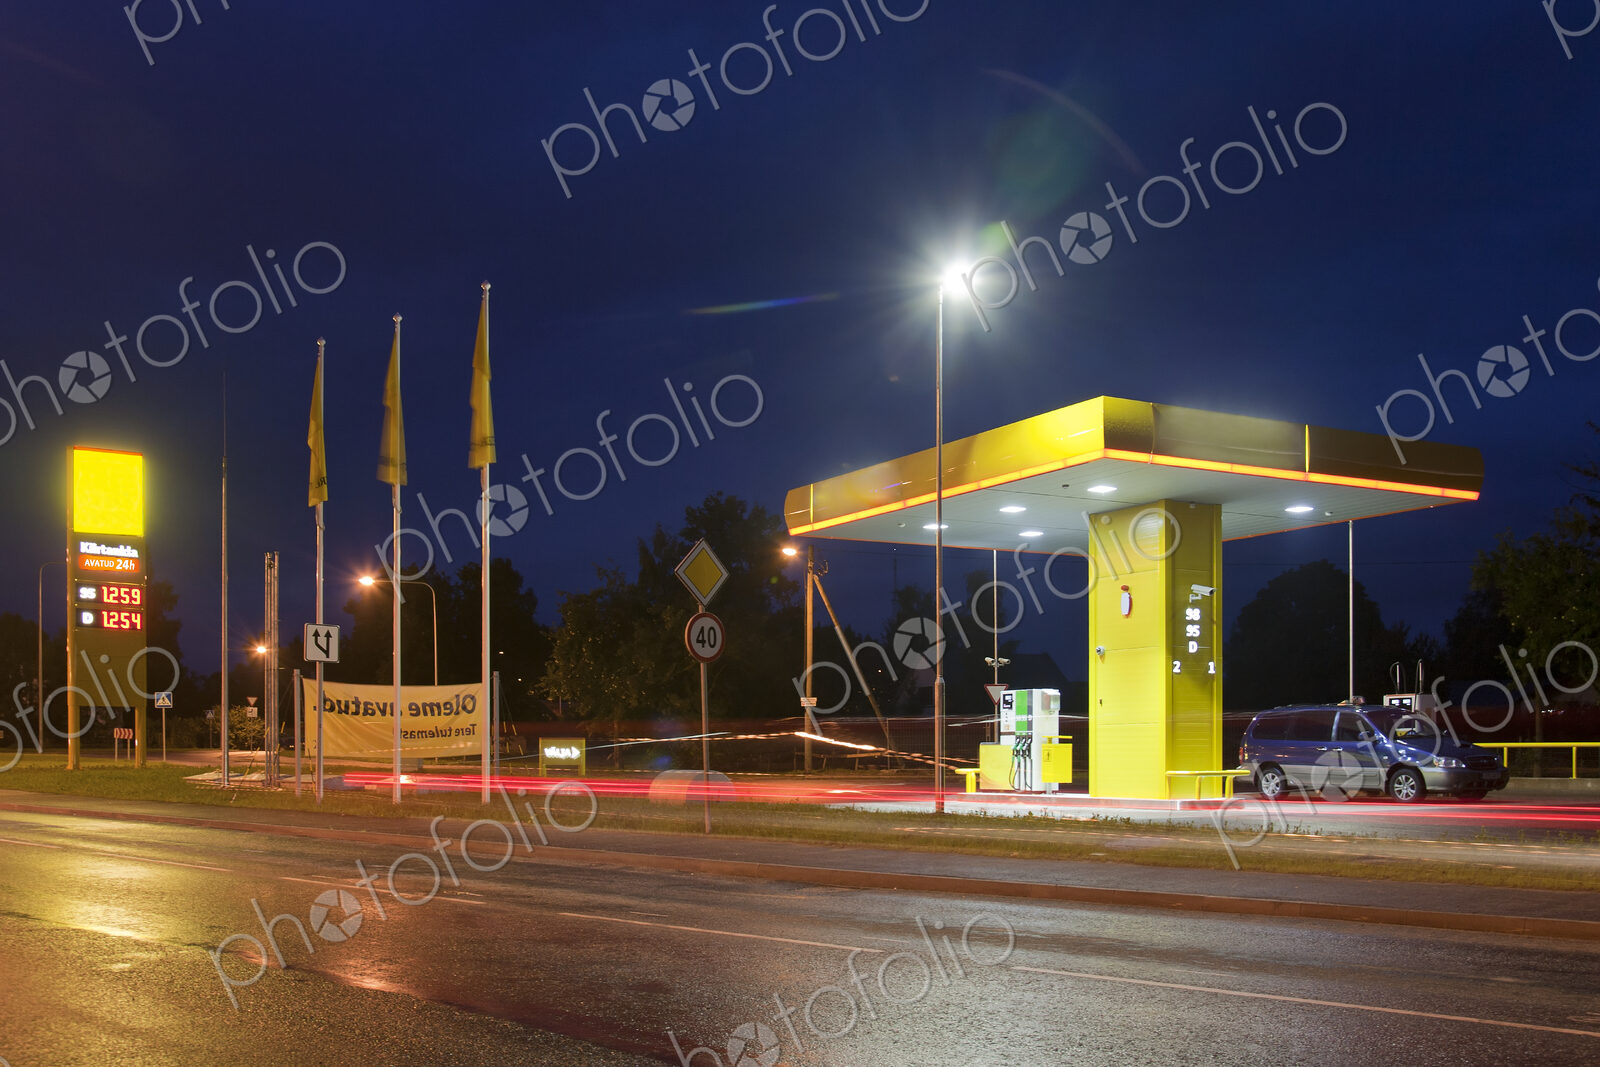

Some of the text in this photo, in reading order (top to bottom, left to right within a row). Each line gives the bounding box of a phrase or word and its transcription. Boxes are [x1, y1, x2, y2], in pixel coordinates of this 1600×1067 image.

[84, 558, 135, 570] AVATUD 24h
[82, 611, 94, 625] D
[1185, 607, 1201, 621] 98
[695, 625, 717, 649] 40
[1185, 624, 1201, 637] 95
[1188, 640, 1199, 653] D
[1172, 660, 1216, 674] 2 1
